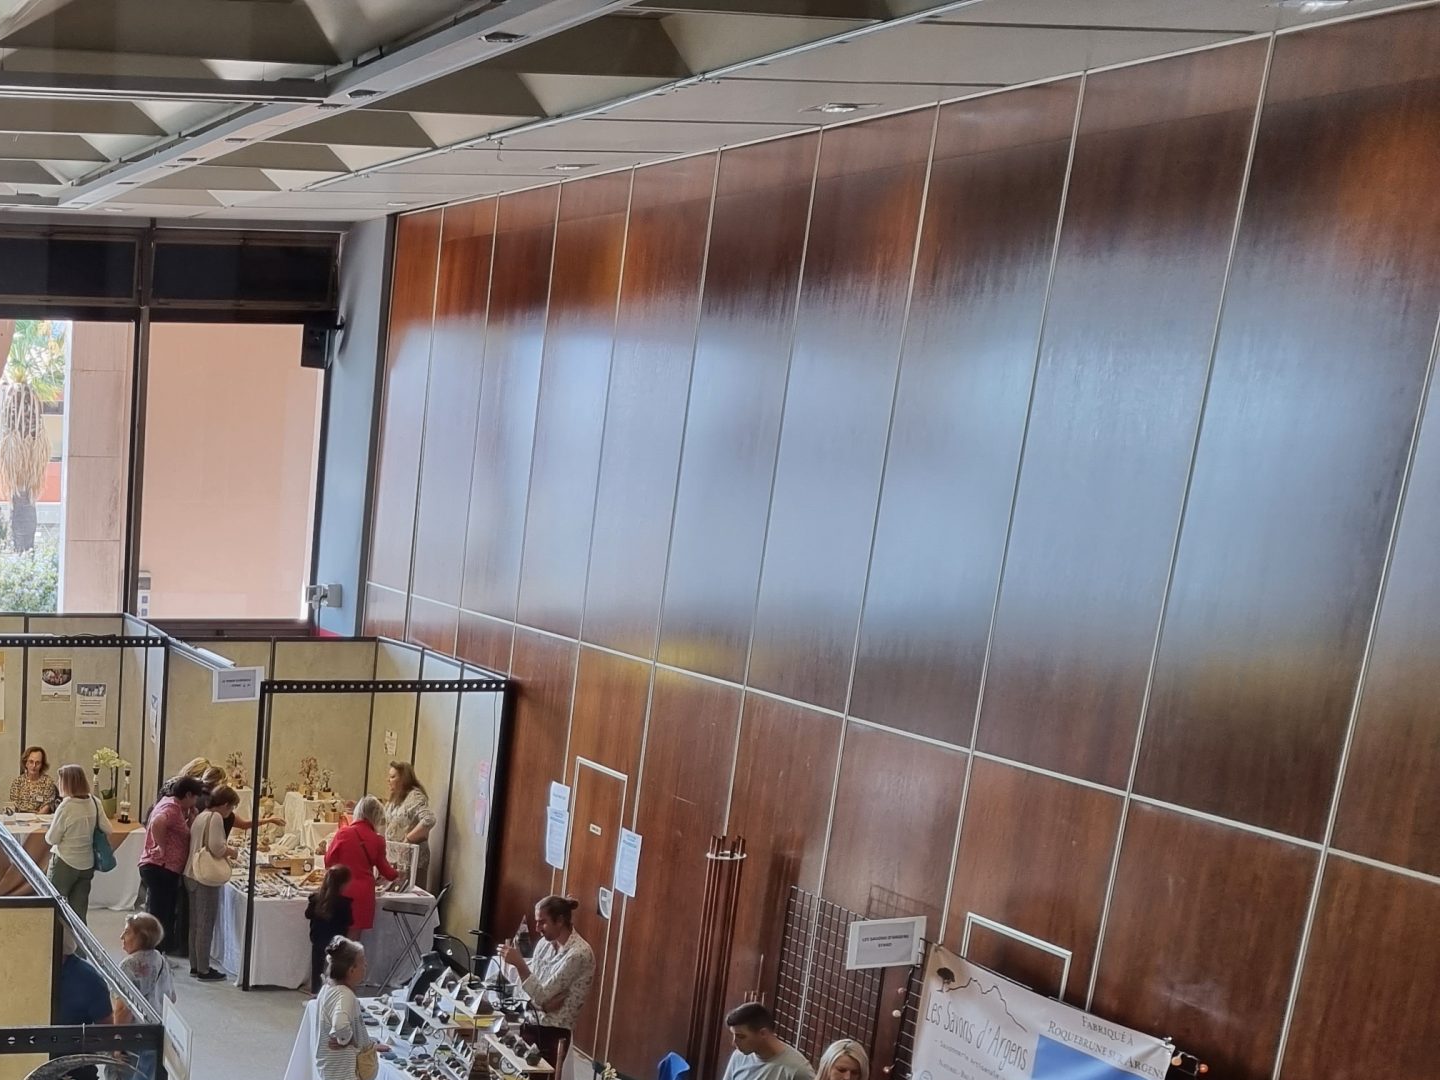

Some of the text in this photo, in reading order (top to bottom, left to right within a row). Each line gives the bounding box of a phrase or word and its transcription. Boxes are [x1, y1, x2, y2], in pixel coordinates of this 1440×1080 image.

[925, 992, 943, 1026] Les
[944, 1000, 976, 1044] Savons
[1081, 1015, 1128, 1043] FABRIQUÉ
[1047, 1020, 1108, 1056] ROQUEBRUNE
[1124, 1056, 1165, 1080] ARGENS
